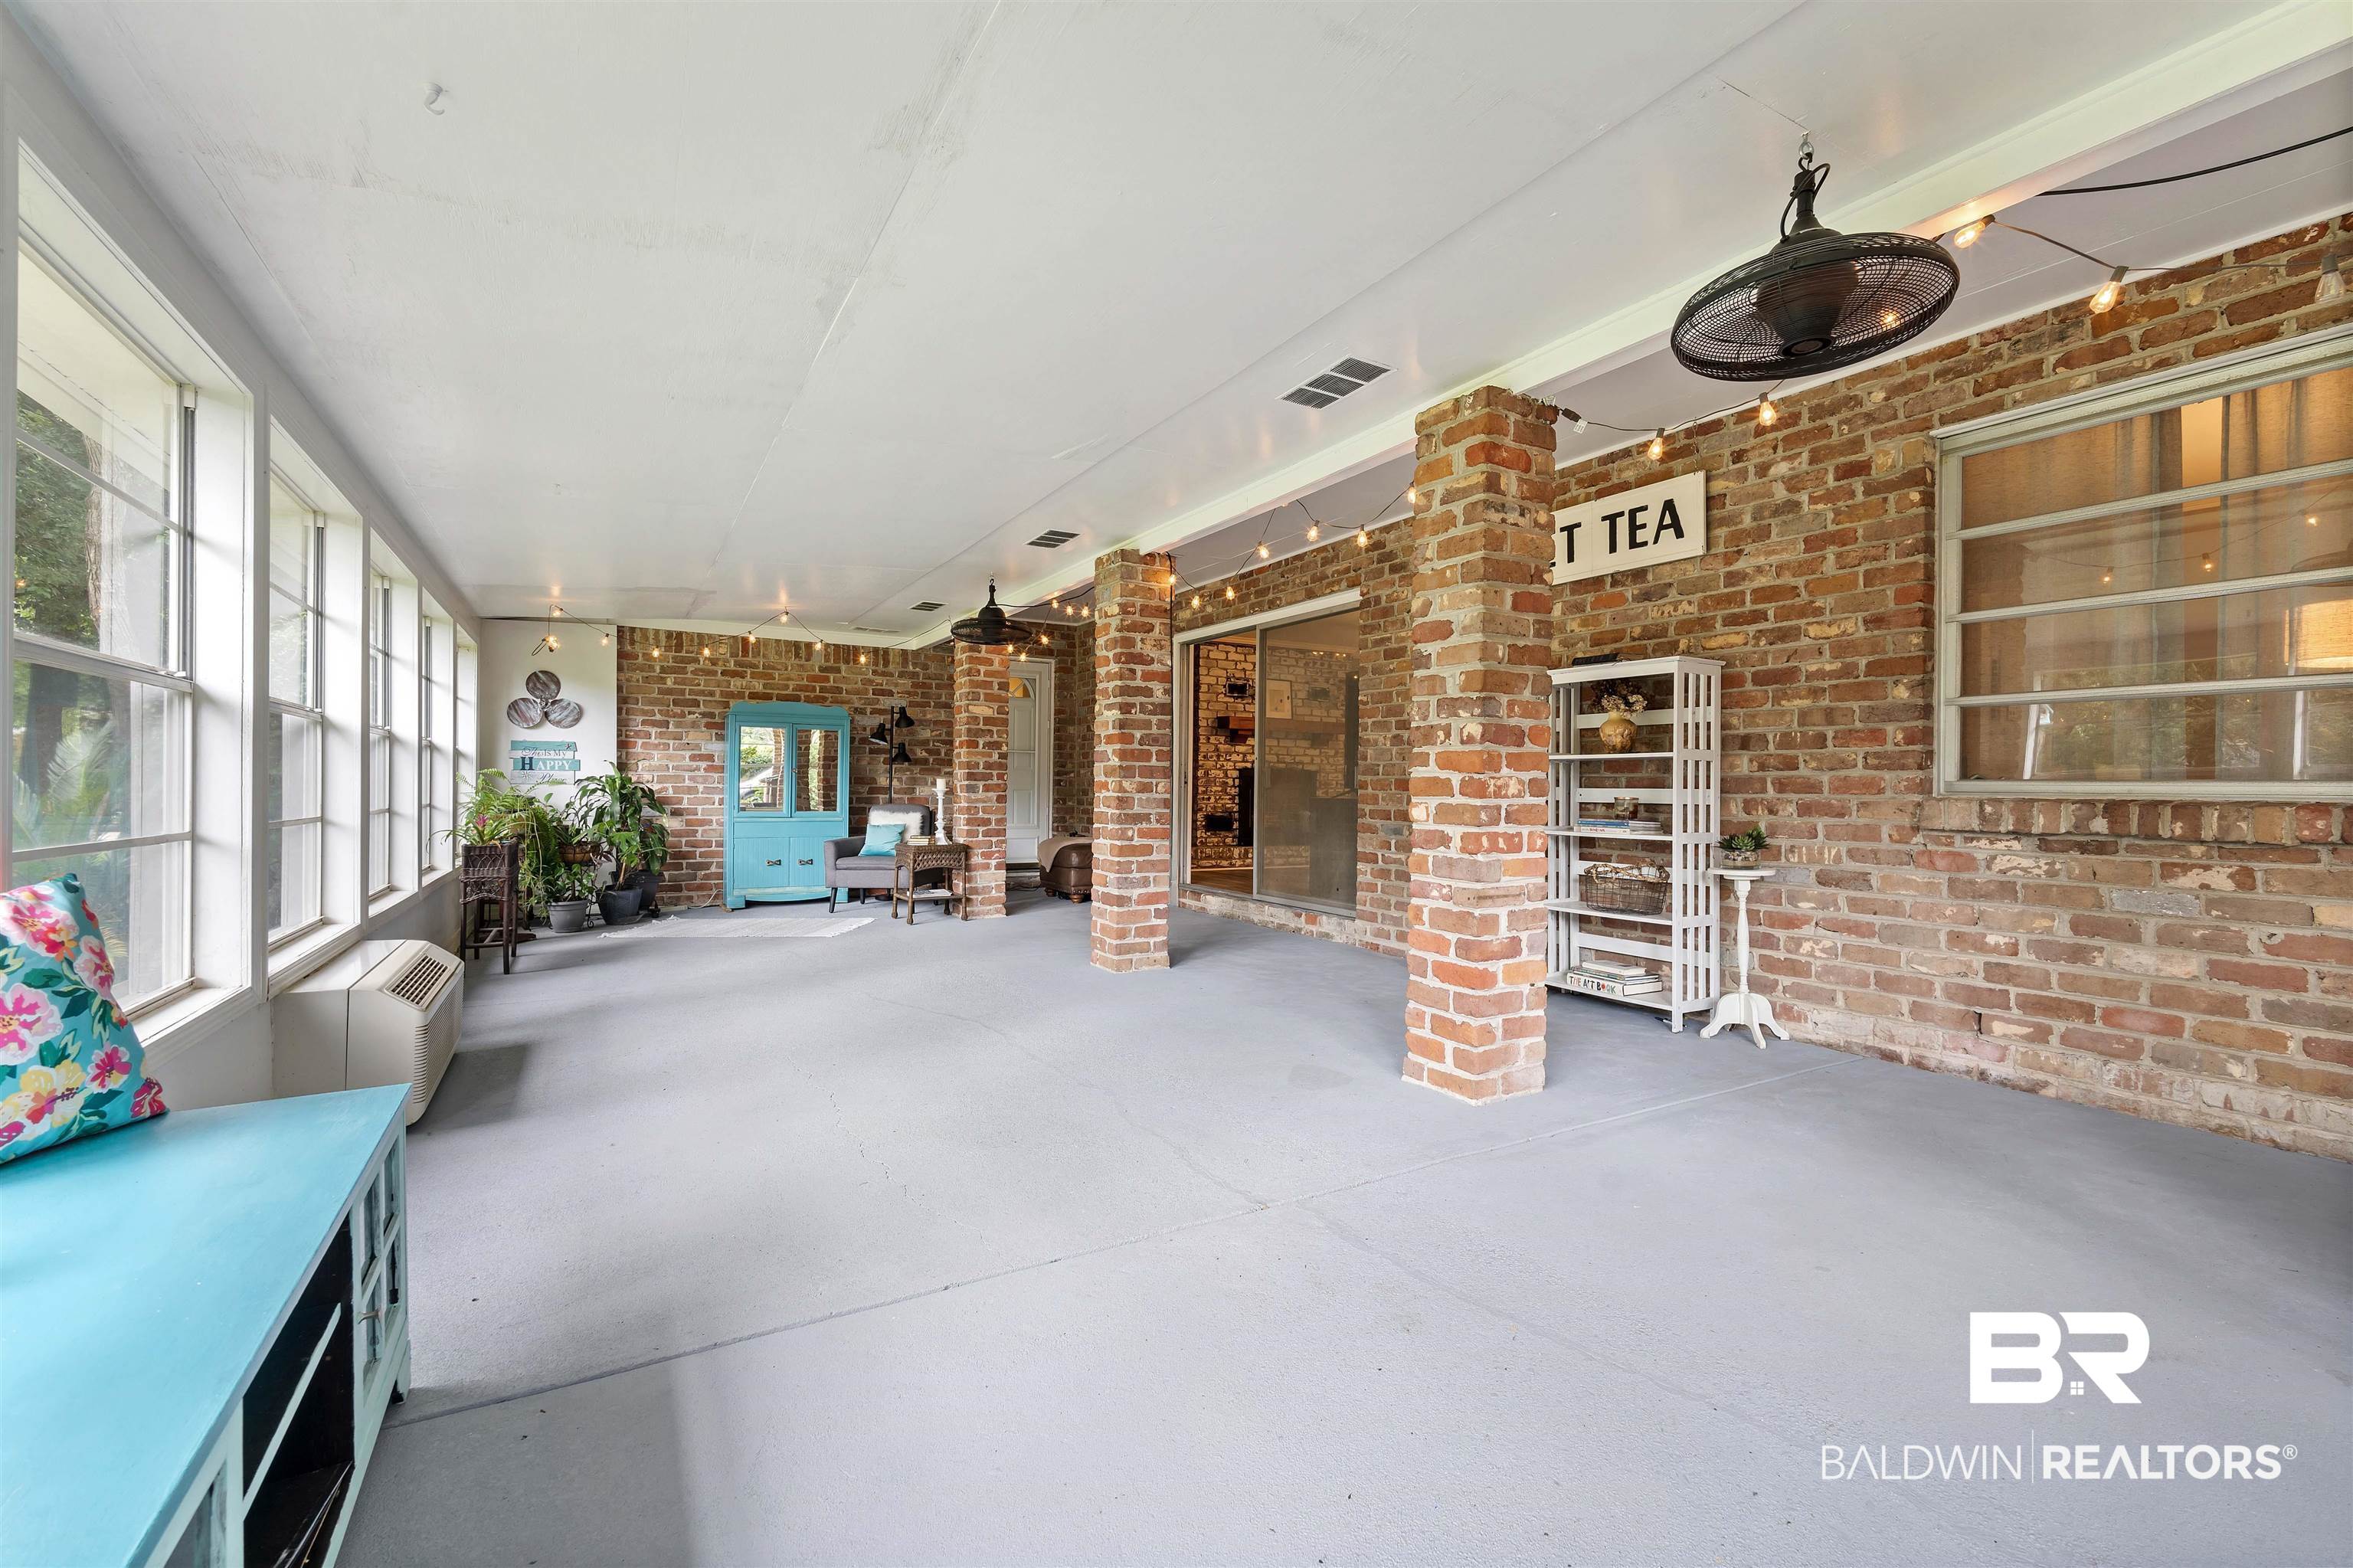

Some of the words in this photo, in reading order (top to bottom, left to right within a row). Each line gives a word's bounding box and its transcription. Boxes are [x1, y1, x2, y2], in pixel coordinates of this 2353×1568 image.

[1550, 522, 1582, 568] T
[1601, 498, 1685, 555] TEA
[521, 757, 571, 771] HAPPY
[1569, 975, 1582, 987] THE
[1596, 981, 1617, 994] BOOK
